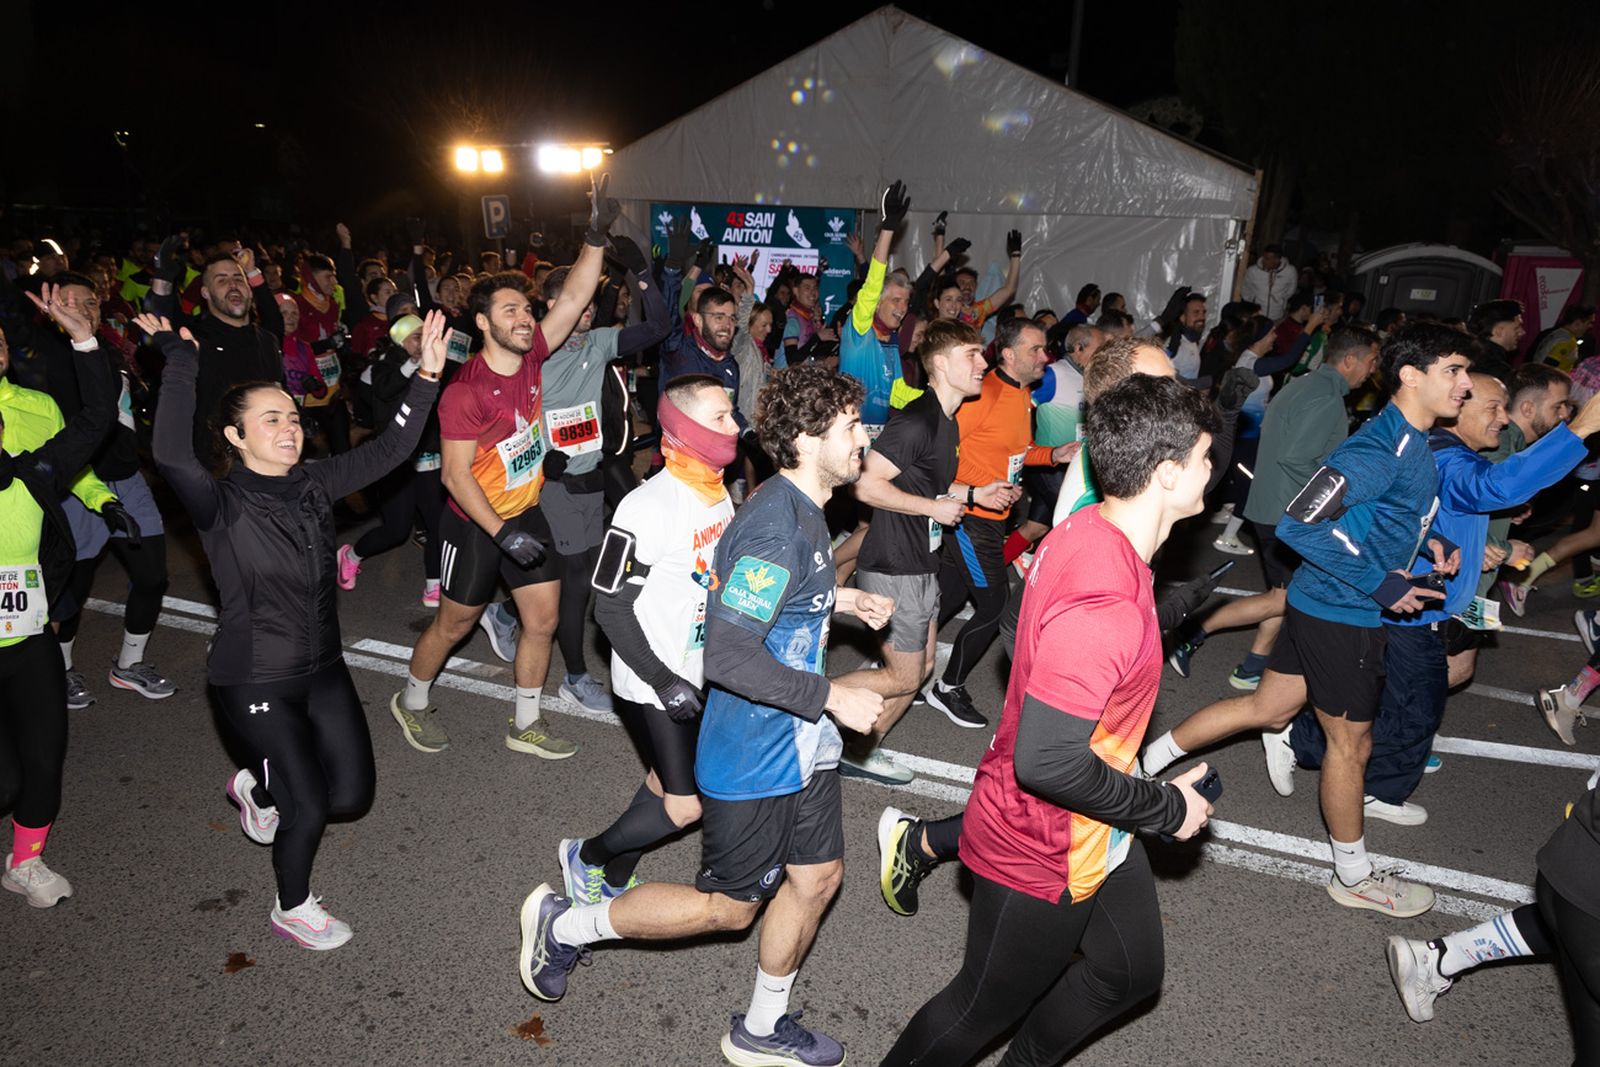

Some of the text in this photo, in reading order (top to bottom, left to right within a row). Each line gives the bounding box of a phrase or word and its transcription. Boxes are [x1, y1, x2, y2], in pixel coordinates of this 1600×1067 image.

[489, 201, 505, 233] P
[726, 211, 775, 228] 43 SAN
[722, 225, 773, 244] ANTÓN
[559, 421, 593, 441] 9839
[511, 440, 542, 473] 12963
[728, 586, 747, 598] CAJA
